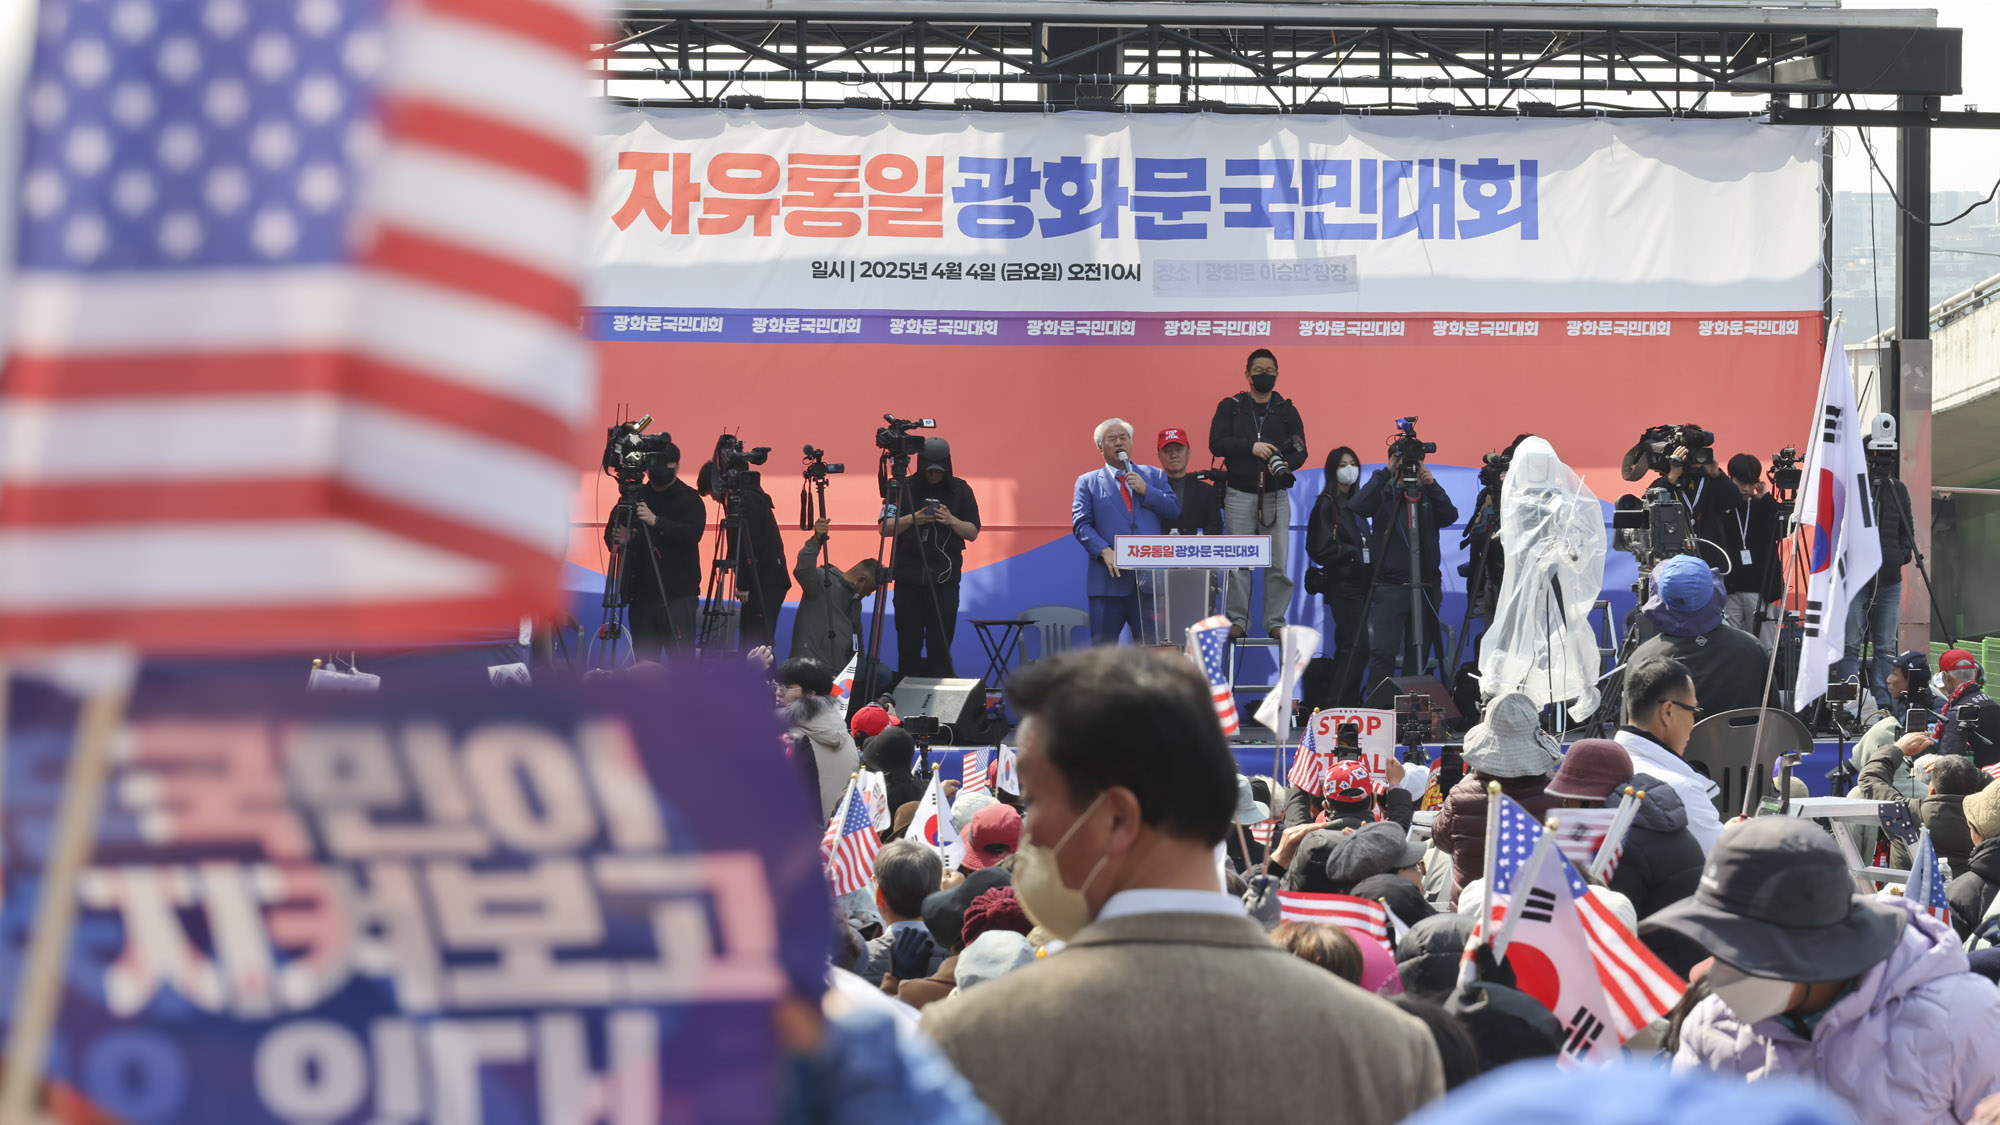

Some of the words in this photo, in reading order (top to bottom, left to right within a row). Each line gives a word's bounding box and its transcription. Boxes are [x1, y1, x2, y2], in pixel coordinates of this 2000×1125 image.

[811, 260, 845, 279] 일시
[859, 260, 928, 281] 2025년
[931, 261, 962, 281] 4월
[965, 262, 996, 282] 4일
[1000, 262, 1063, 282] (금요일)
[1067, 263, 1141, 282] 오전10시
[1157, 263, 1191, 283] 장소
[1205, 263, 1256, 282] 광화문
[1260, 262, 1310, 282] 이승만
[1312, 263, 1348, 282] 광장
[112, 718, 668, 862] 국민이
